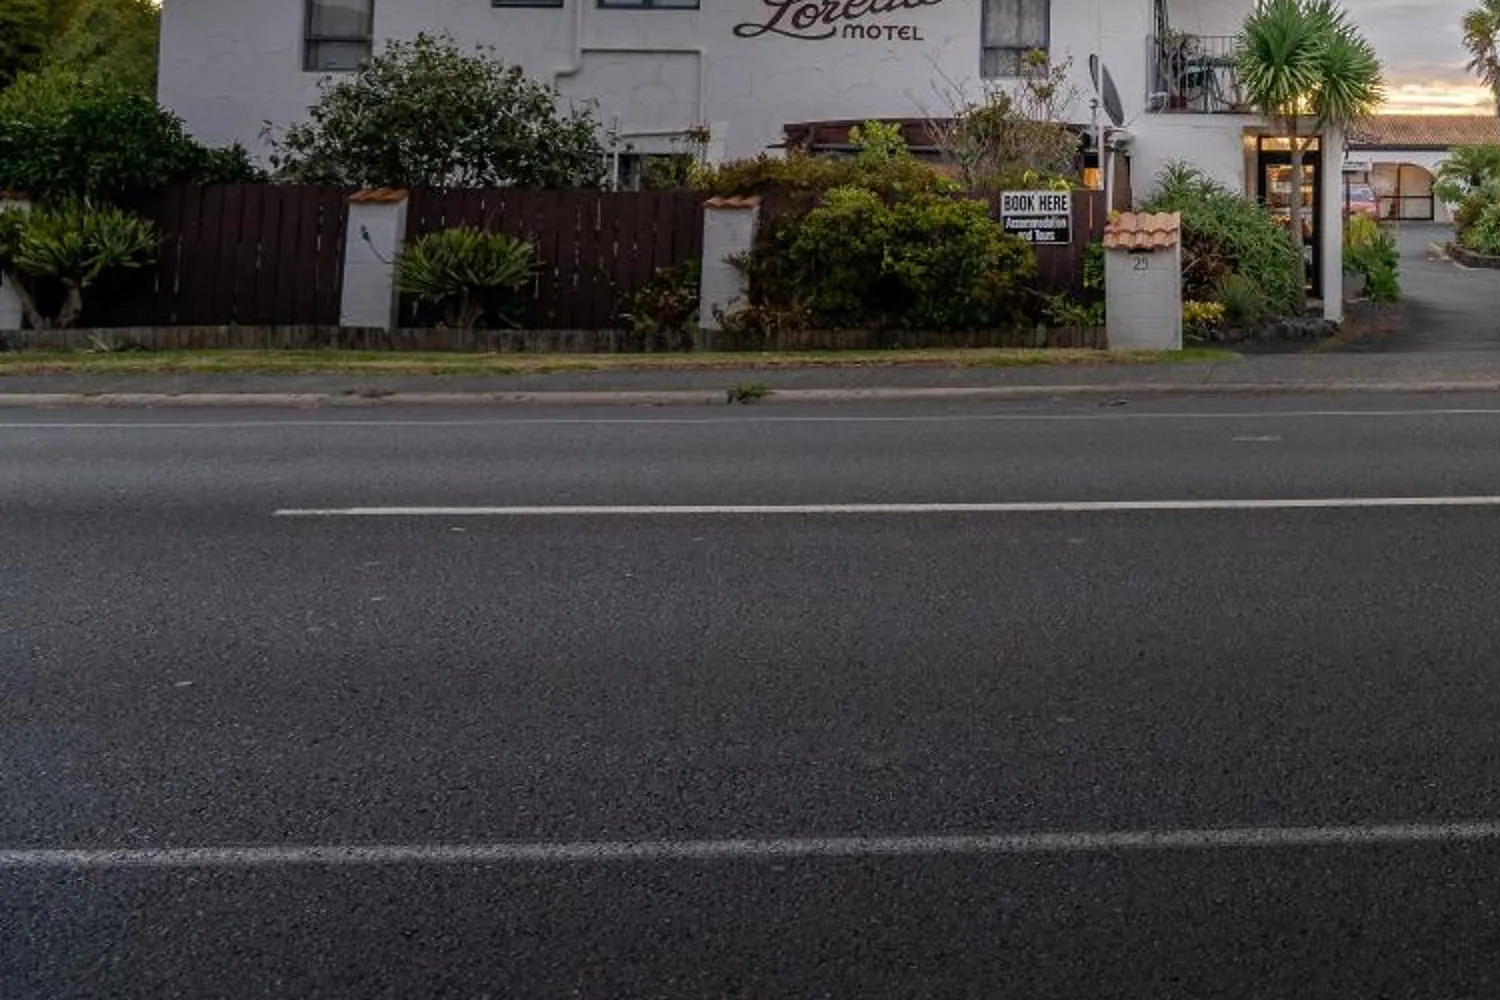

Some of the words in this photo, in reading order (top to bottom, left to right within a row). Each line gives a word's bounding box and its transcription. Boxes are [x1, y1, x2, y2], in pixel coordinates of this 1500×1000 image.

[842, 24, 924, 41] MOTEL
[1004, 195, 1035, 212] BOOK
[1040, 195, 1068, 212] HERE
